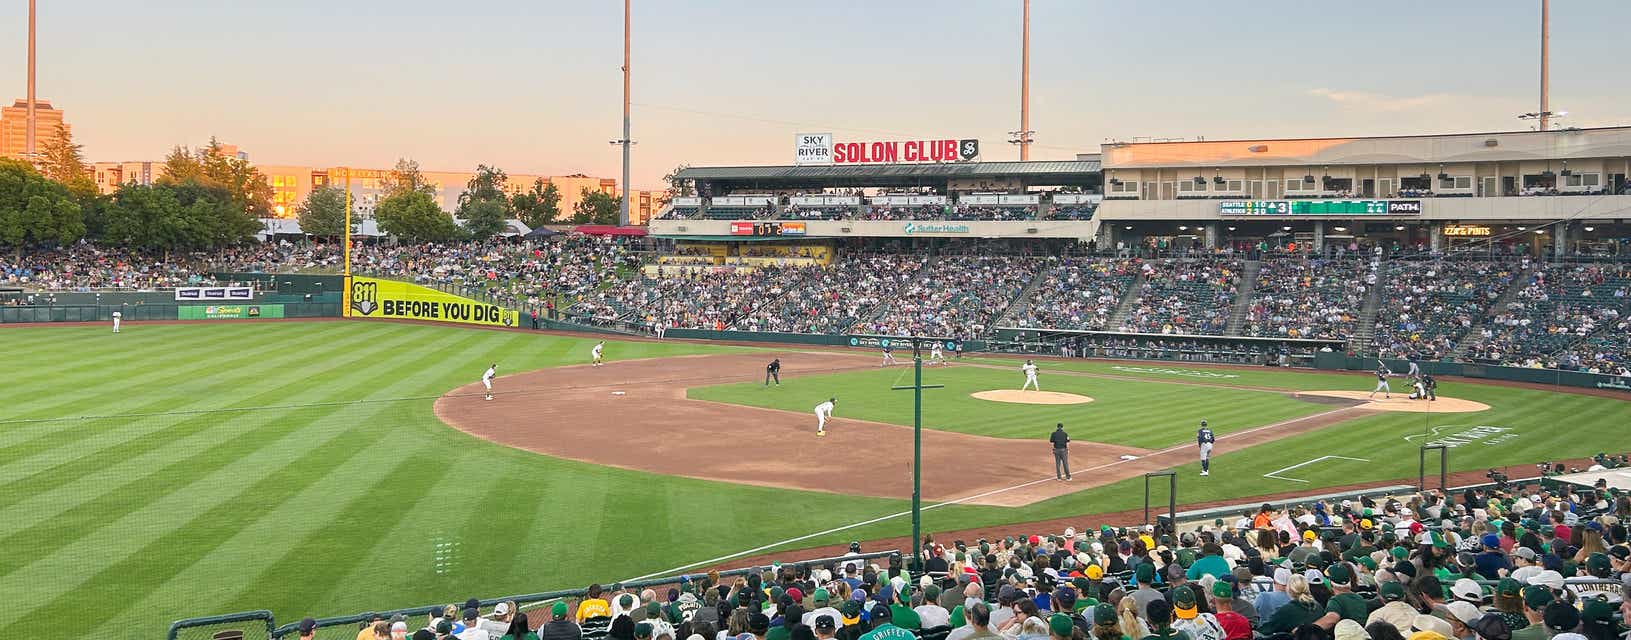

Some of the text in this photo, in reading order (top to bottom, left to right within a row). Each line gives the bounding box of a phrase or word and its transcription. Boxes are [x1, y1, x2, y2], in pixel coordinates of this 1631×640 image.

[803, 136, 824, 145] SKY
[798, 148, 829, 157] RIVER
[833, 140, 958, 163] SOLON CLUB
[1278, 203, 1286, 213] 3
[918, 224, 969, 233] Sutter Health
[352, 282, 377, 303] 811
[383, 300, 500, 323] BEFORE YOU DIG
